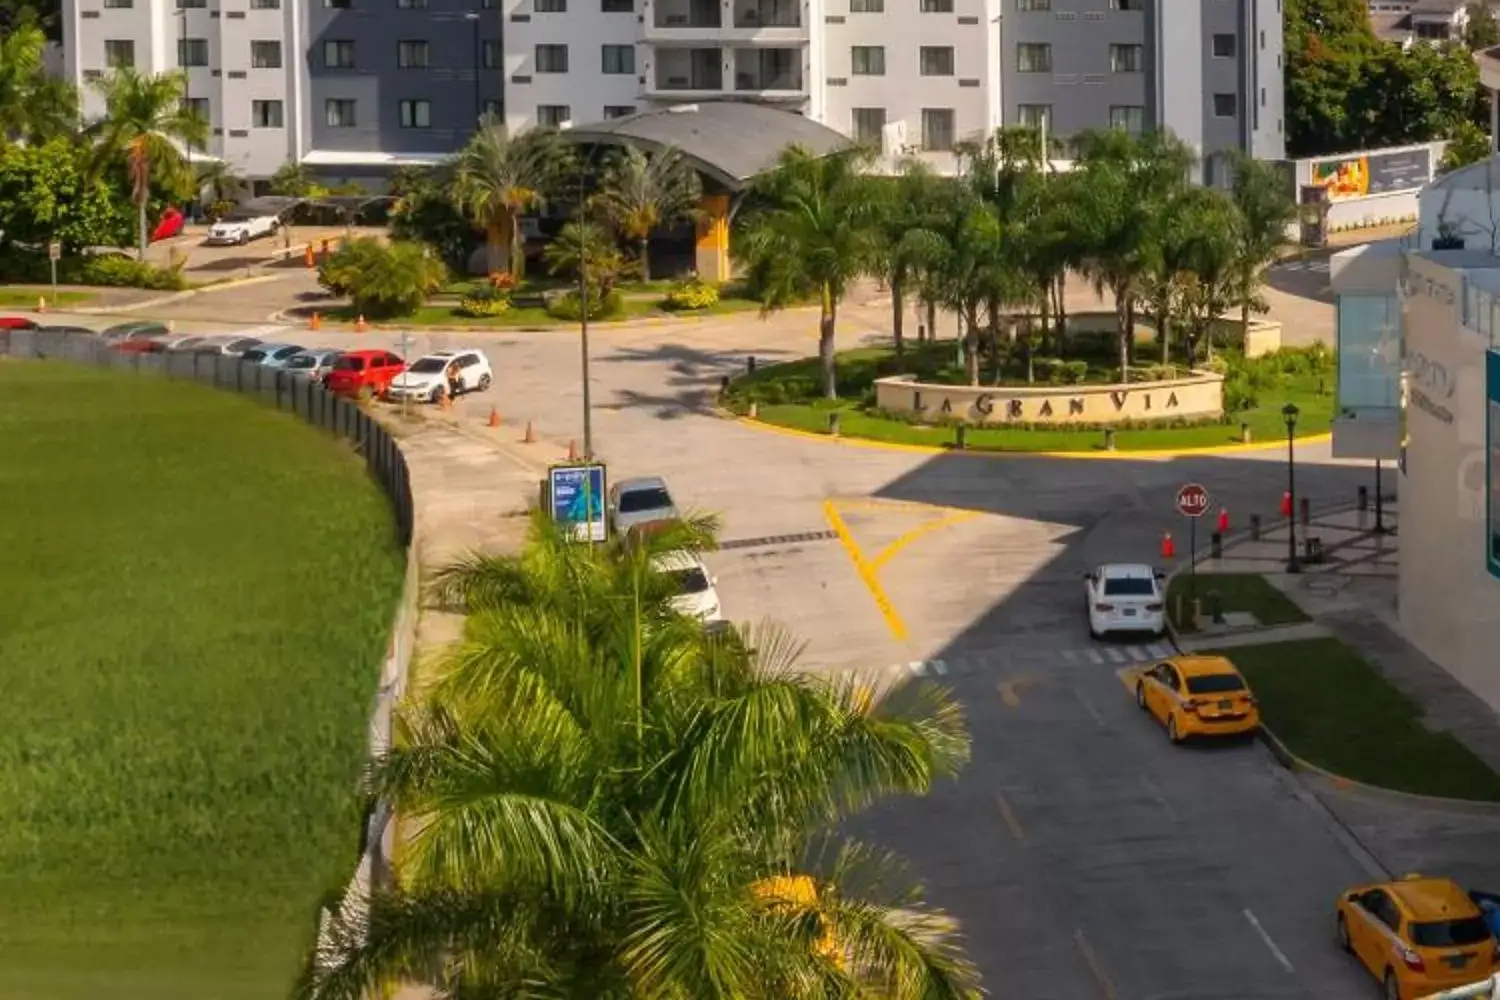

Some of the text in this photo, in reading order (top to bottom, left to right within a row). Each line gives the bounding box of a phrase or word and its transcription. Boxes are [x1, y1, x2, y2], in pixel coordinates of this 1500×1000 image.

[913, 390, 1180, 417] LA GRAN VIA
[1180, 494, 1206, 507] ALTO
